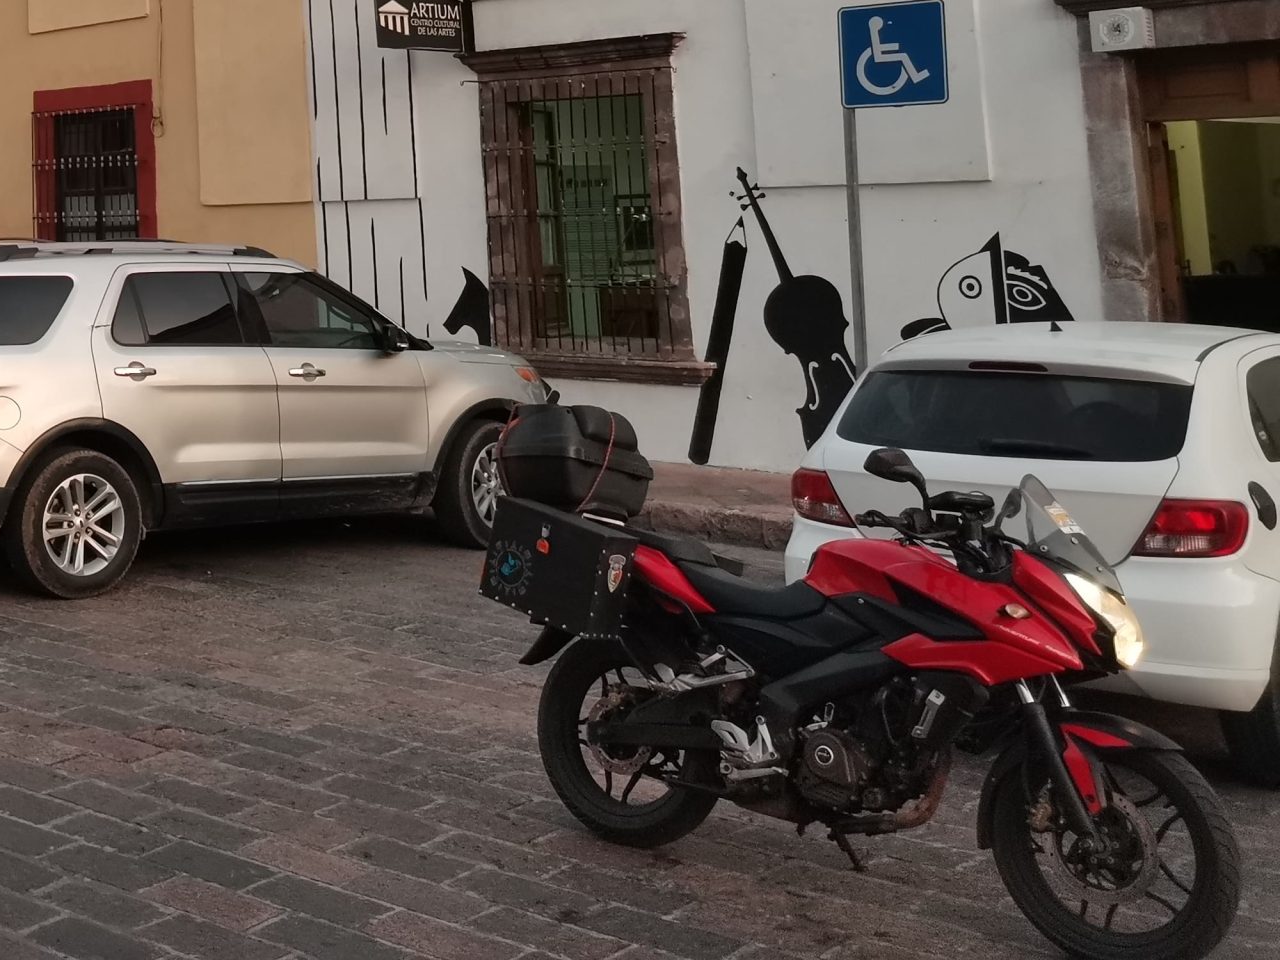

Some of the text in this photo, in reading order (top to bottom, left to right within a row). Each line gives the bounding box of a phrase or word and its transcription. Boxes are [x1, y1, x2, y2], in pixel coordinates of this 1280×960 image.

[410, 2, 460, 20] ARTIUM
[434, 20, 460, 28] CULTURAL
[417, 27, 456, 37] DE LAS ARTES
